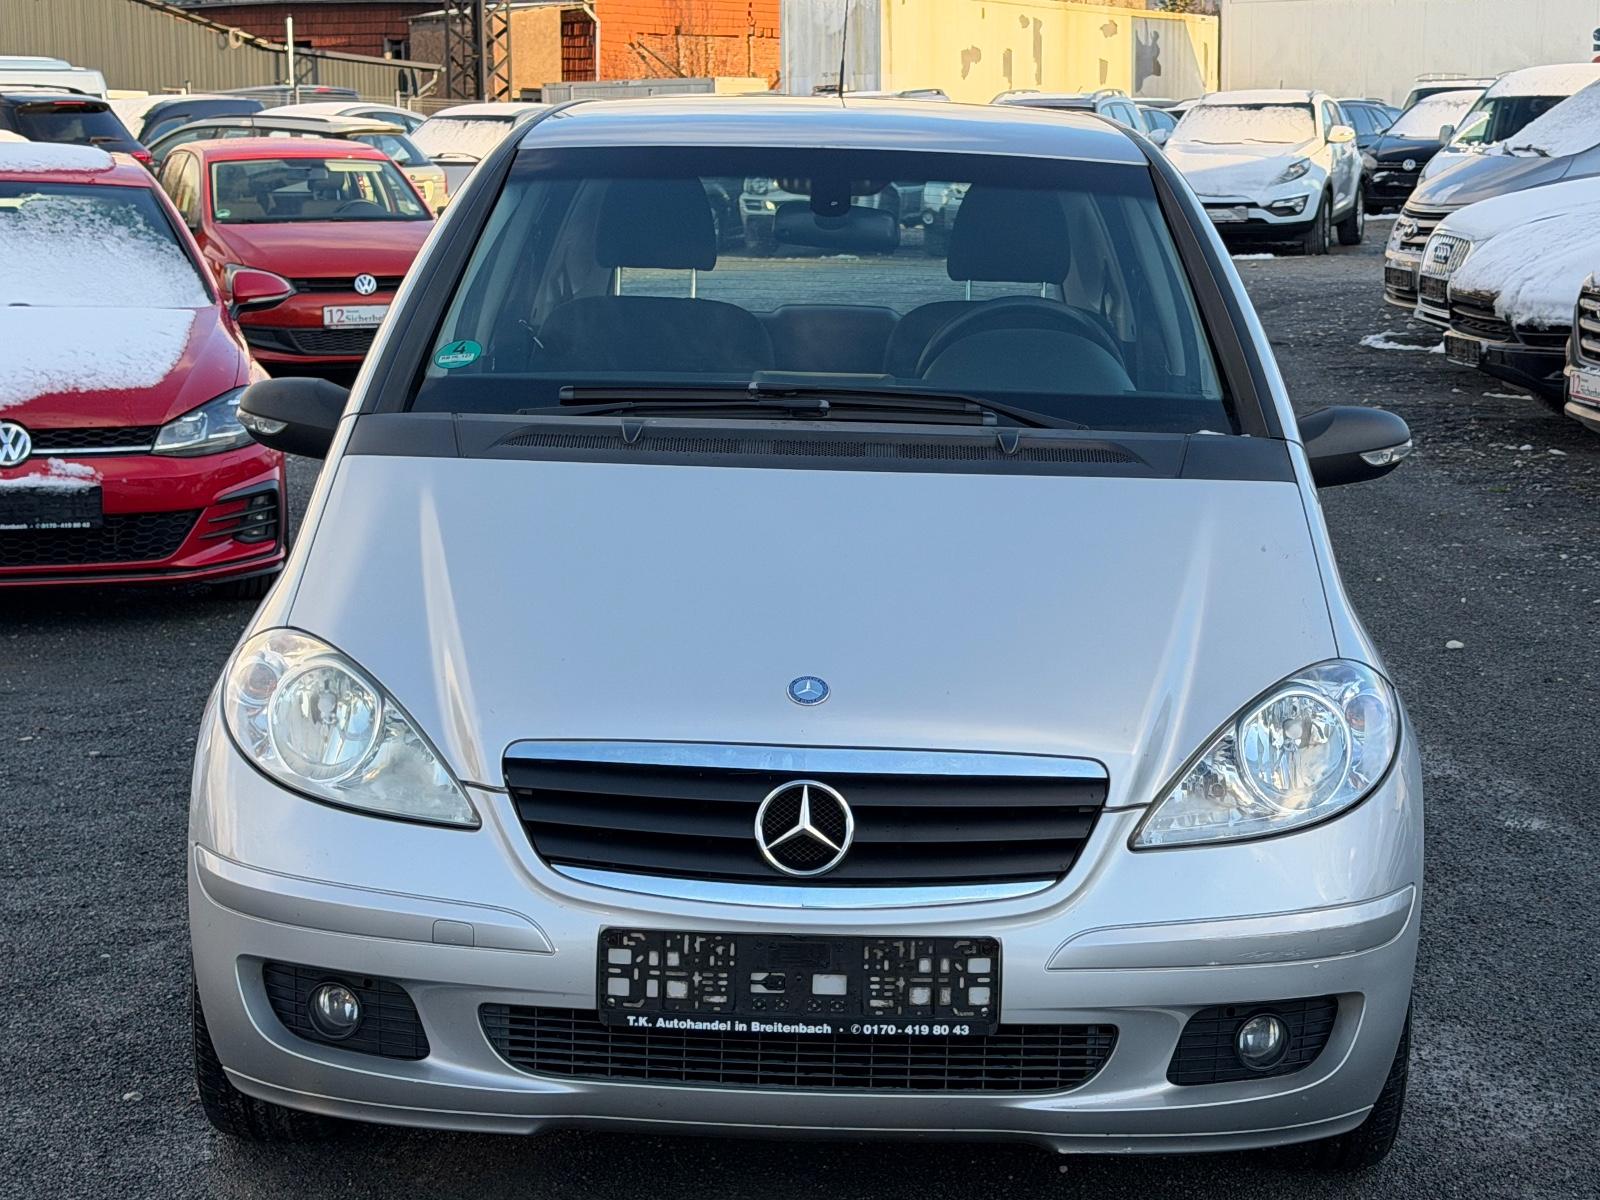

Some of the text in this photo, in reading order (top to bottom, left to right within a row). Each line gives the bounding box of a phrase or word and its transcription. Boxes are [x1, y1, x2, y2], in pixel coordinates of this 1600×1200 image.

[326, 308, 345, 324] 12
[452, 341, 466, 354] 4
[626, 1015, 653, 1027] T.K.
[656, 1017, 731, 1031] Autohandel
[734, 1020, 748, 1032] in
[751, 1021, 832, 1034] Breitenbach
[932, 1024, 950, 1036] 80
[952, 1024, 970, 1036] 43
